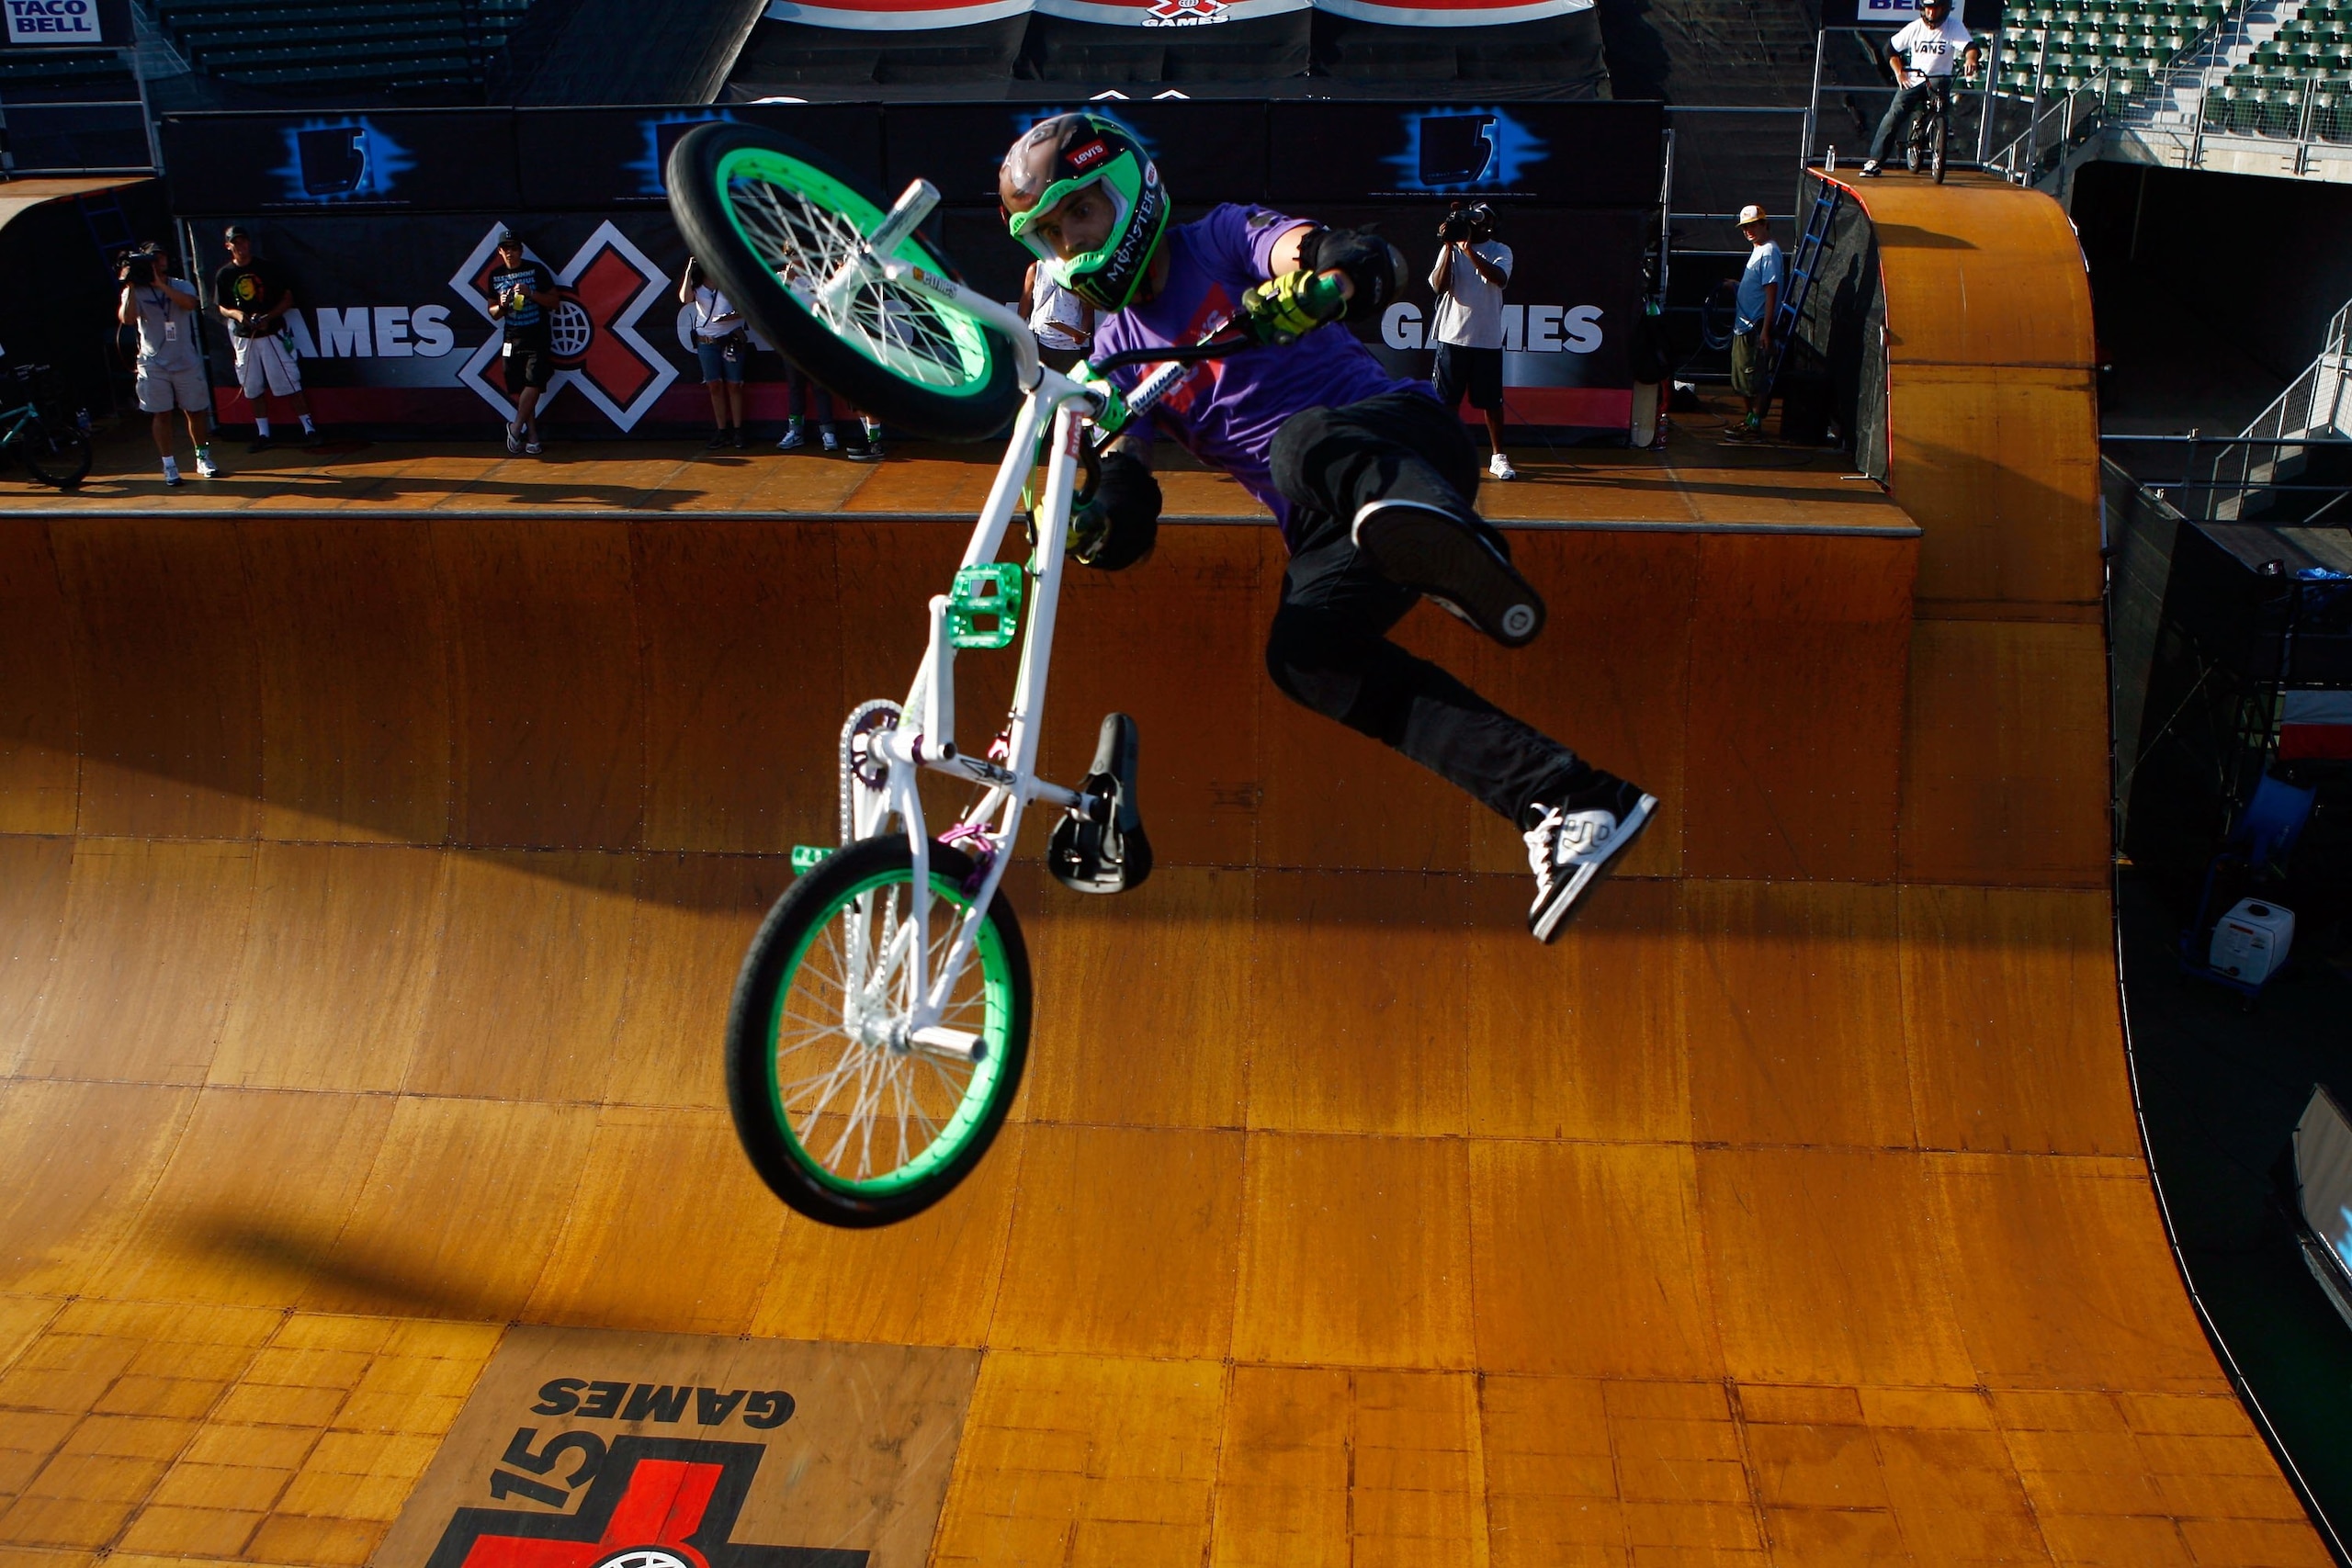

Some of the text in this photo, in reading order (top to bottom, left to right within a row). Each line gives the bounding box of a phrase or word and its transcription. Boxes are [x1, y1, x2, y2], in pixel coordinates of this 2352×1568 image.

[7, 1, 87, 16] TACO
[16, 17, 92, 32] BELL
[1142, 16, 1229, 27] GAMES
[1914, 40, 1947, 55] VANS
[281, 304, 455, 358] AMES
[529, 1378, 797, 1429] GAMES
[490, 1427, 607, 1509] 15
